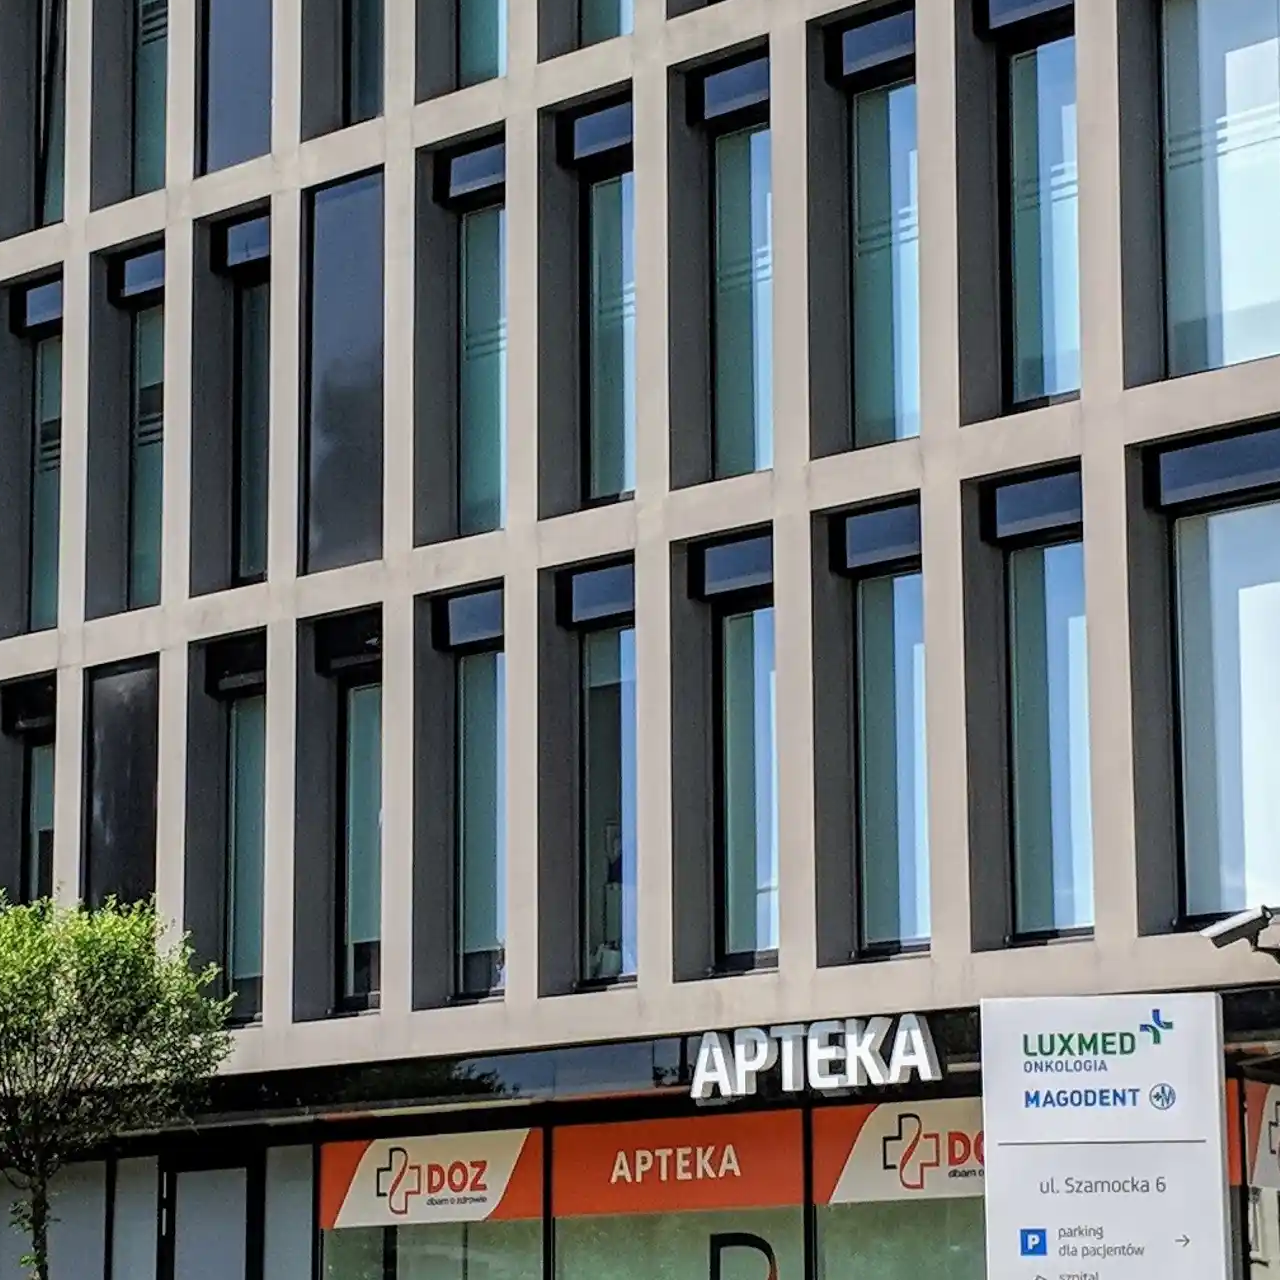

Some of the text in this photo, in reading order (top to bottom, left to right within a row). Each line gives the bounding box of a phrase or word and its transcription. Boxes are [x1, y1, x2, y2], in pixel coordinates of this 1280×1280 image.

[1023, 1031, 1136, 1057] LUXMED
[690, 1013, 943, 1102] APTEKA
[1023, 1059, 1108, 1073] ONKOLOGIA
[1024, 1088, 1141, 1108] MAGODENT
[611, 1144, 741, 1183] APTEKA
[427, 1160, 488, 1194] DOZ
[1039, 1176, 1167, 1195] ul. Szamocka 6
[1027, 1234, 1040, 1250] P
[1058, 1226, 1103, 1240] parking
[1058, 1243, 1144, 1259] dla pacjentów
